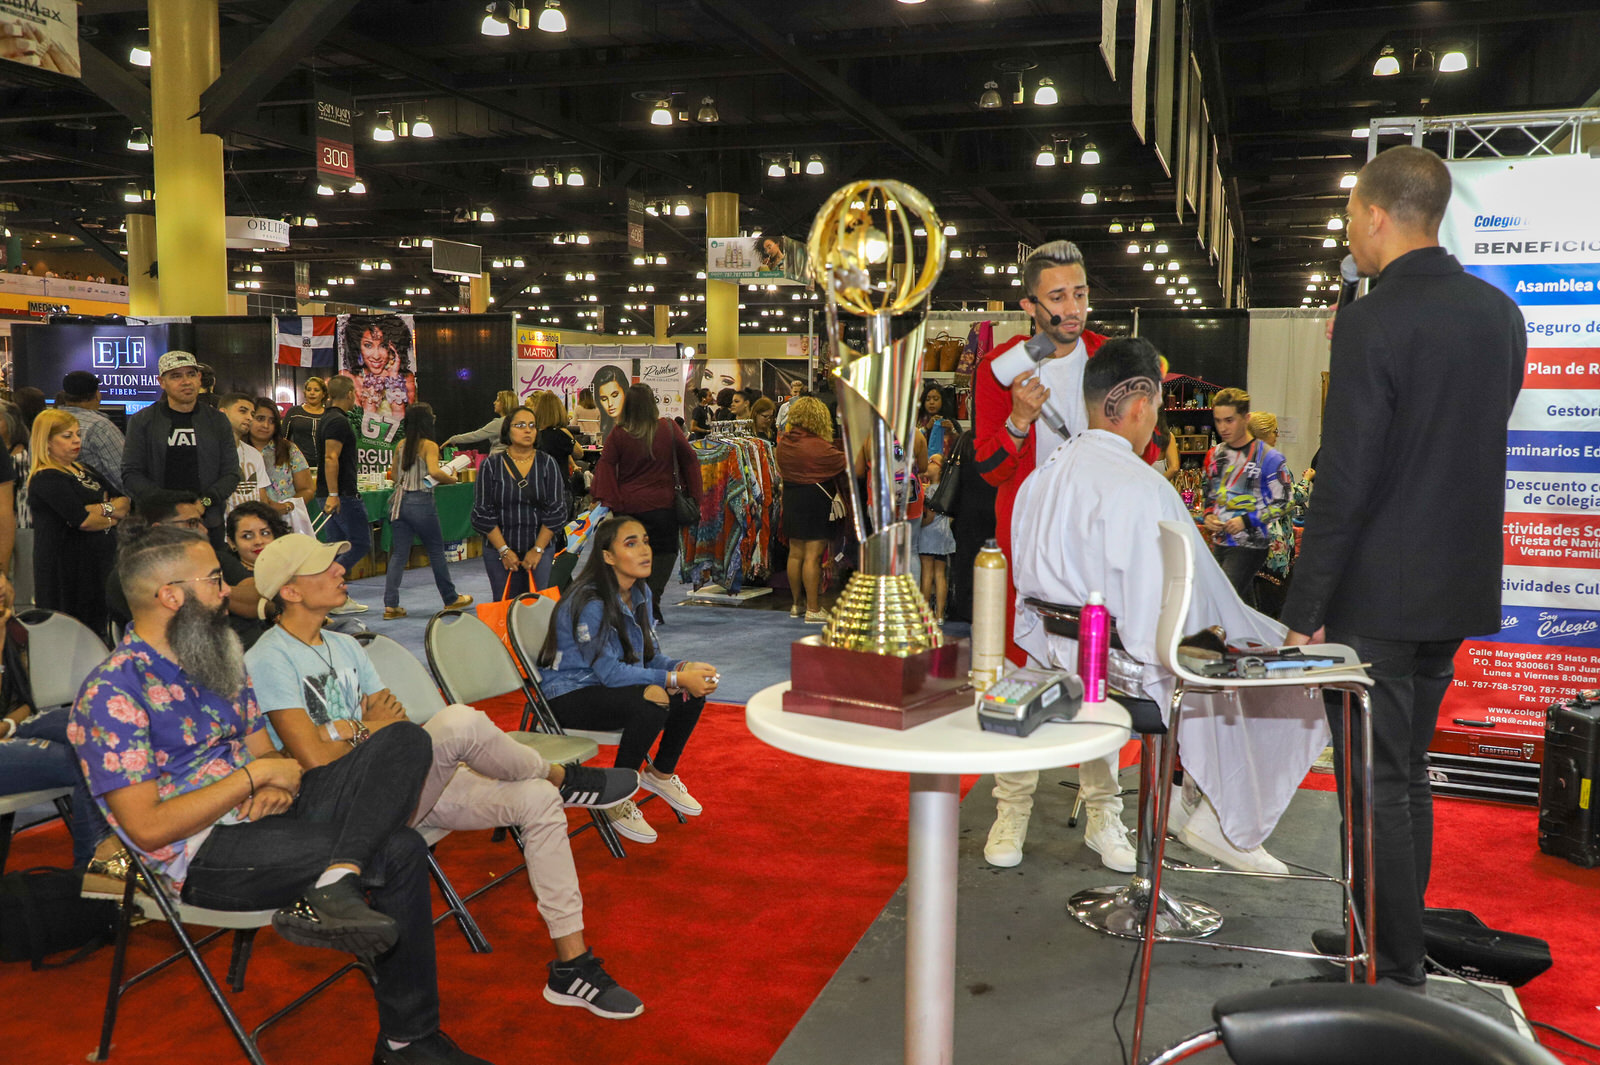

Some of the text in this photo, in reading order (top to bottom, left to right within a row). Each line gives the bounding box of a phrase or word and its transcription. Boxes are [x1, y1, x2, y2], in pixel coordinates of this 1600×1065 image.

[323, 147, 349, 169] 300
[1474, 215, 1521, 228] Colegio
[630, 228, 642, 242] 400
[1515, 278, 1594, 292] Asamblea
[1526, 321, 1581, 336] Seguro
[97, 336, 143, 369] EHF
[523, 347, 555, 358] MATRIX
[1527, 362, 1600, 375] Plan de R
[520, 362, 579, 397] Lovina
[109, 388, 137, 396] FIBERS
[361, 413, 401, 443] G7
[1505, 443, 1580, 458] eminarios
[1505, 478, 1600, 493] Descuento c
[1523, 492, 1542, 505] de
[1502, 521, 1580, 537] ctividades
[1510, 534, 1600, 548] (Fiesta de Navi
[1519, 546, 1562, 558] Verano
[1501, 578, 1571, 594] tividades
[1538, 611, 1558, 622] Soy
[1537, 619, 1598, 638] Colegio
[1468, 647, 1493, 656] Calle
[1495, 649, 1542, 661] Mayagüez
[1544, 652, 1562, 661] #29
[1564, 653, 1588, 663] Hato
[1473, 658, 1492, 667] P.O.
[1494, 659, 1513, 668] Box
[1515, 661, 1554, 671] 9300661
[1557, 663, 1576, 672] San
[1483, 668, 1512, 678] Lunes
[1523, 671, 1560, 681] Viernes
[1562, 674, 1597, 684] 8:00am
[1453, 679, 1586, 695] Tel. 787-758-5790, 787-758-
[1519, 694, 1536, 703] Fax
[1480, 747, 1519, 756] CRAFTSMAN
